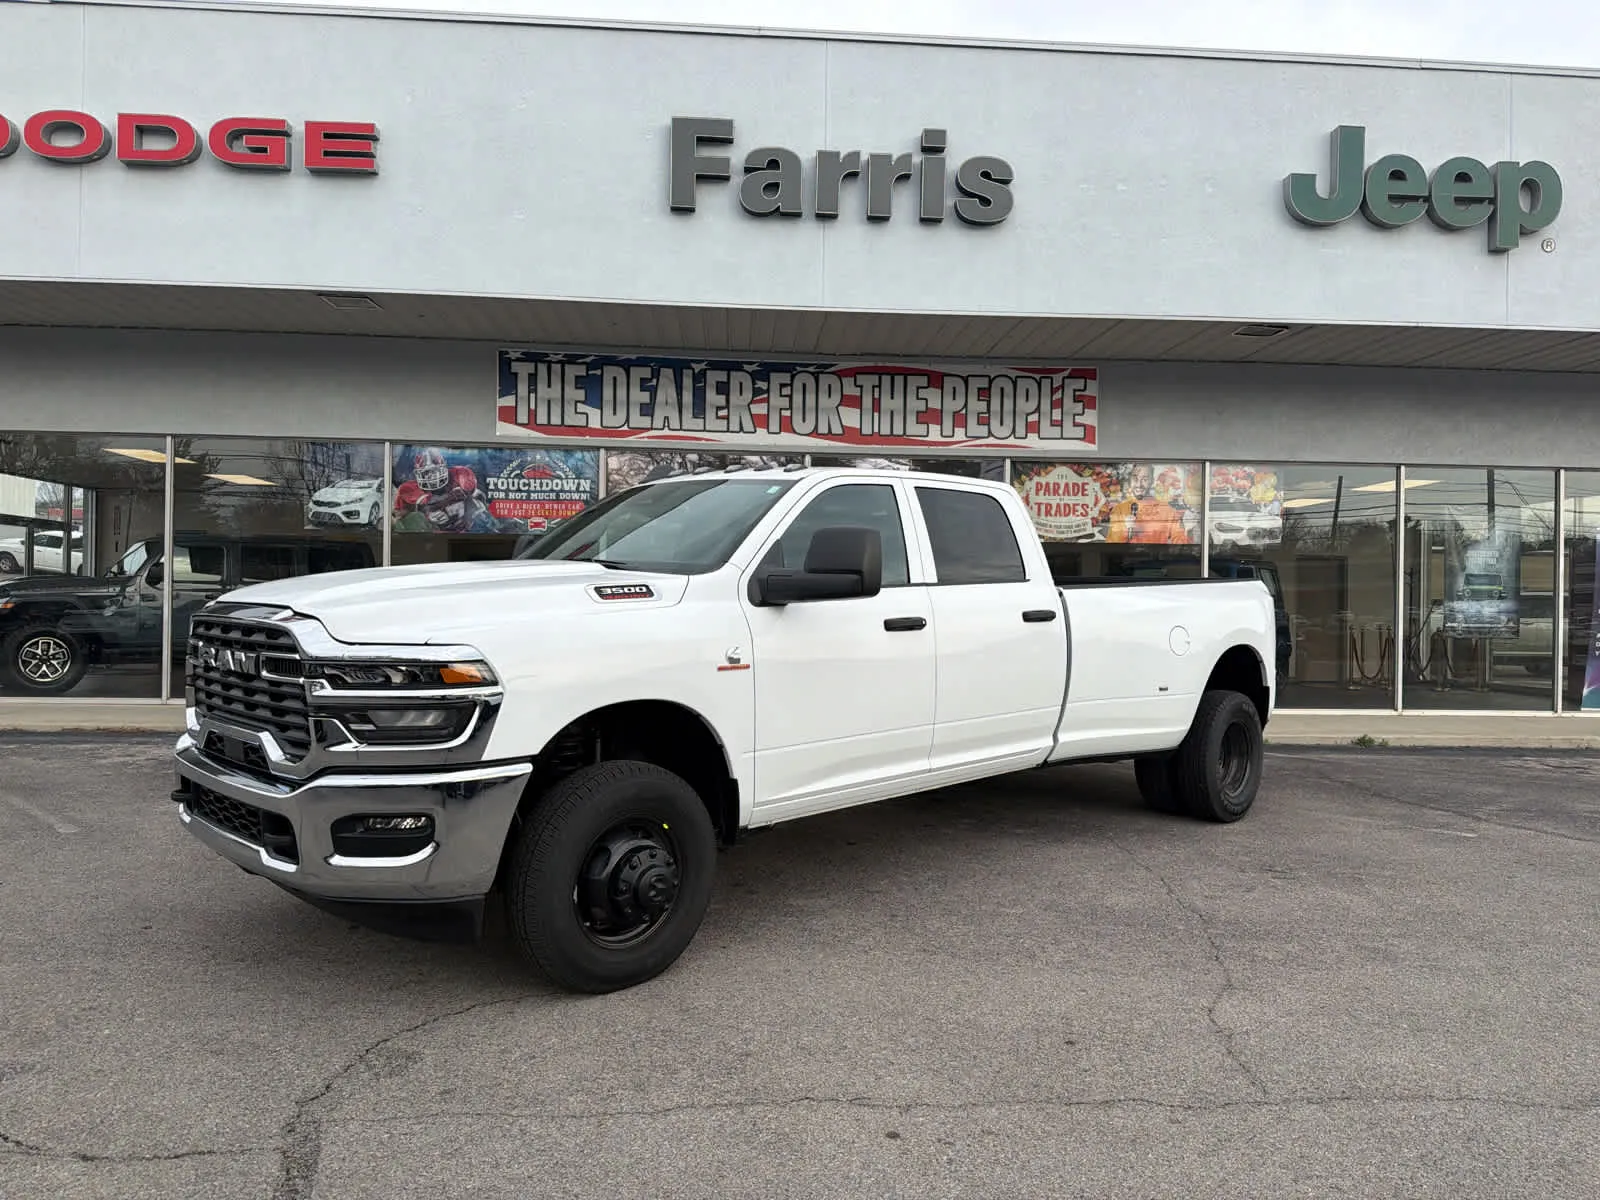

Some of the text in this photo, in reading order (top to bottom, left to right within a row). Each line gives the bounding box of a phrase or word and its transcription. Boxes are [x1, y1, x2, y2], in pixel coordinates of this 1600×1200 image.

[0, 109, 379, 175] ODGE
[669, 116, 1015, 225] Farris
[1283, 125, 1564, 252] Jeep
[510, 360, 1087, 440] THE DEALER FOR THE PEOPLE
[486, 477, 592, 491] TOUCHDOWN
[1035, 481, 1090, 497] PARADE
[488, 491, 506, 499] FOR
[508, 492, 528, 500] NOT
[530, 492, 556, 500] MUCH
[1034, 502, 1090, 518] TRADES
[599, 586, 648, 595] 3500
[199, 647, 257, 674] RAM
